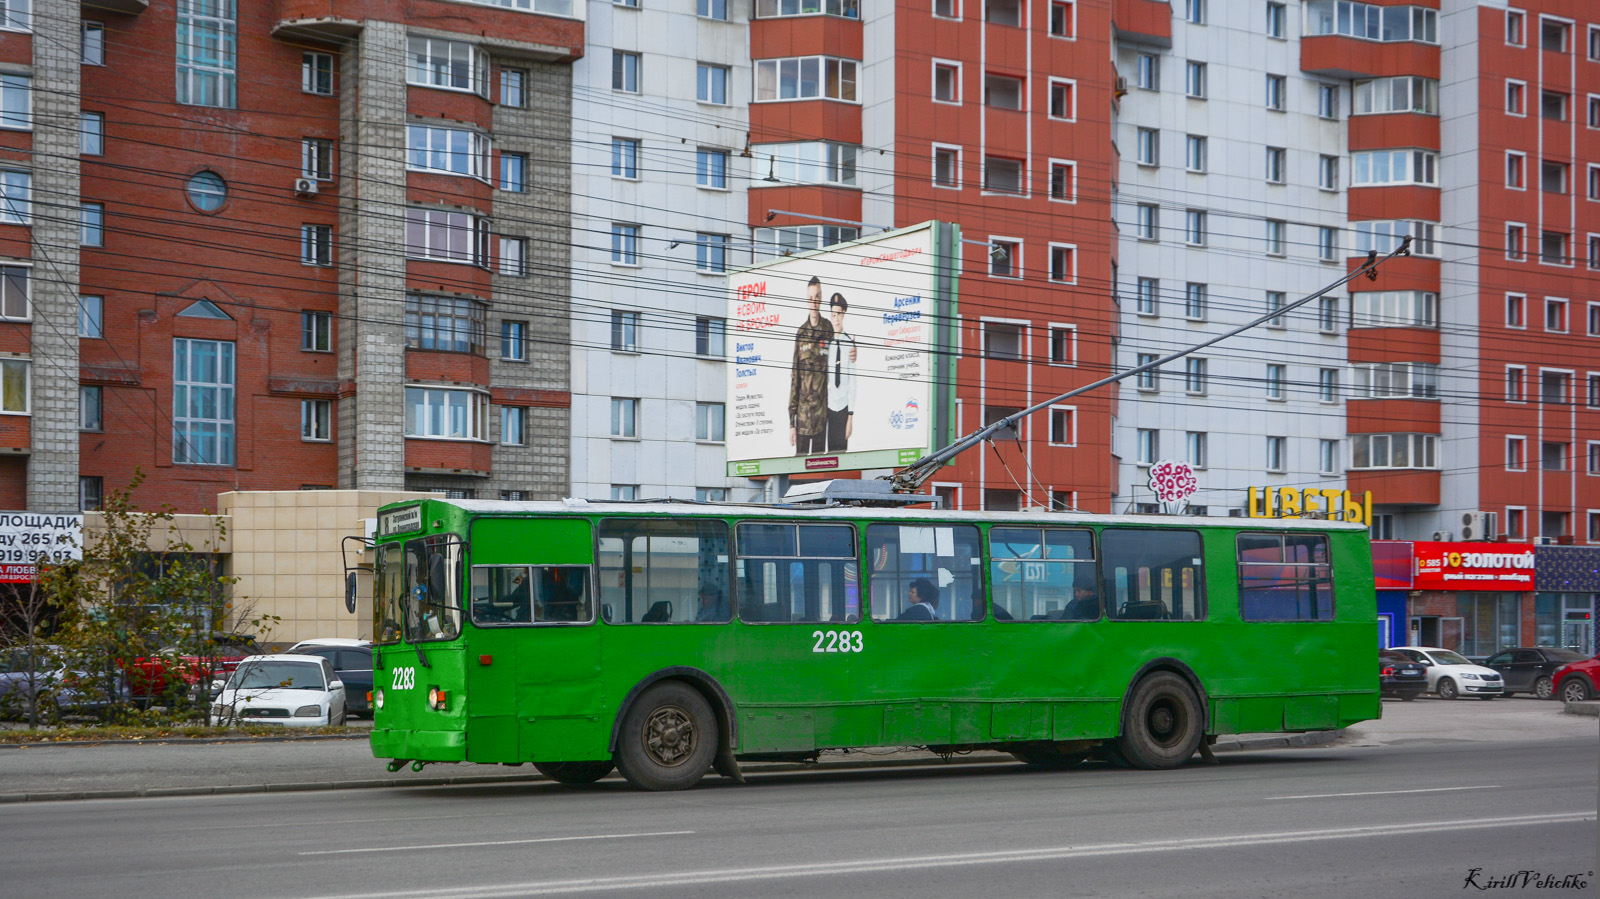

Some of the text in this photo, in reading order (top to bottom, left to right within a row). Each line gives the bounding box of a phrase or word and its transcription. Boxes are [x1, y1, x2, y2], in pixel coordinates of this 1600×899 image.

[737, 281, 766, 301] ГЕРОИ
[737, 301, 766, 317] #СВОИХ
[894, 292, 921, 309] Арсений
[746, 314, 780, 331] БРОСАЕМ
[736, 342, 754, 353] Виктор
[736, 368, 757, 378] Толстых
[1248, 485, 1373, 527] ЦВЕТЫ
[0, 515, 77, 530] ЛОЩАДИ
[385, 516, 390, 534] 8
[22, 532, 51, 545] 265
[1426, 558, 1441, 567] 585
[1461, 550, 1535, 569] ЗОЛОТОЙ
[6, 566, 39, 574] ЛЮБВ
[812, 630, 864, 653] 2283
[392, 666, 415, 690] 2283
